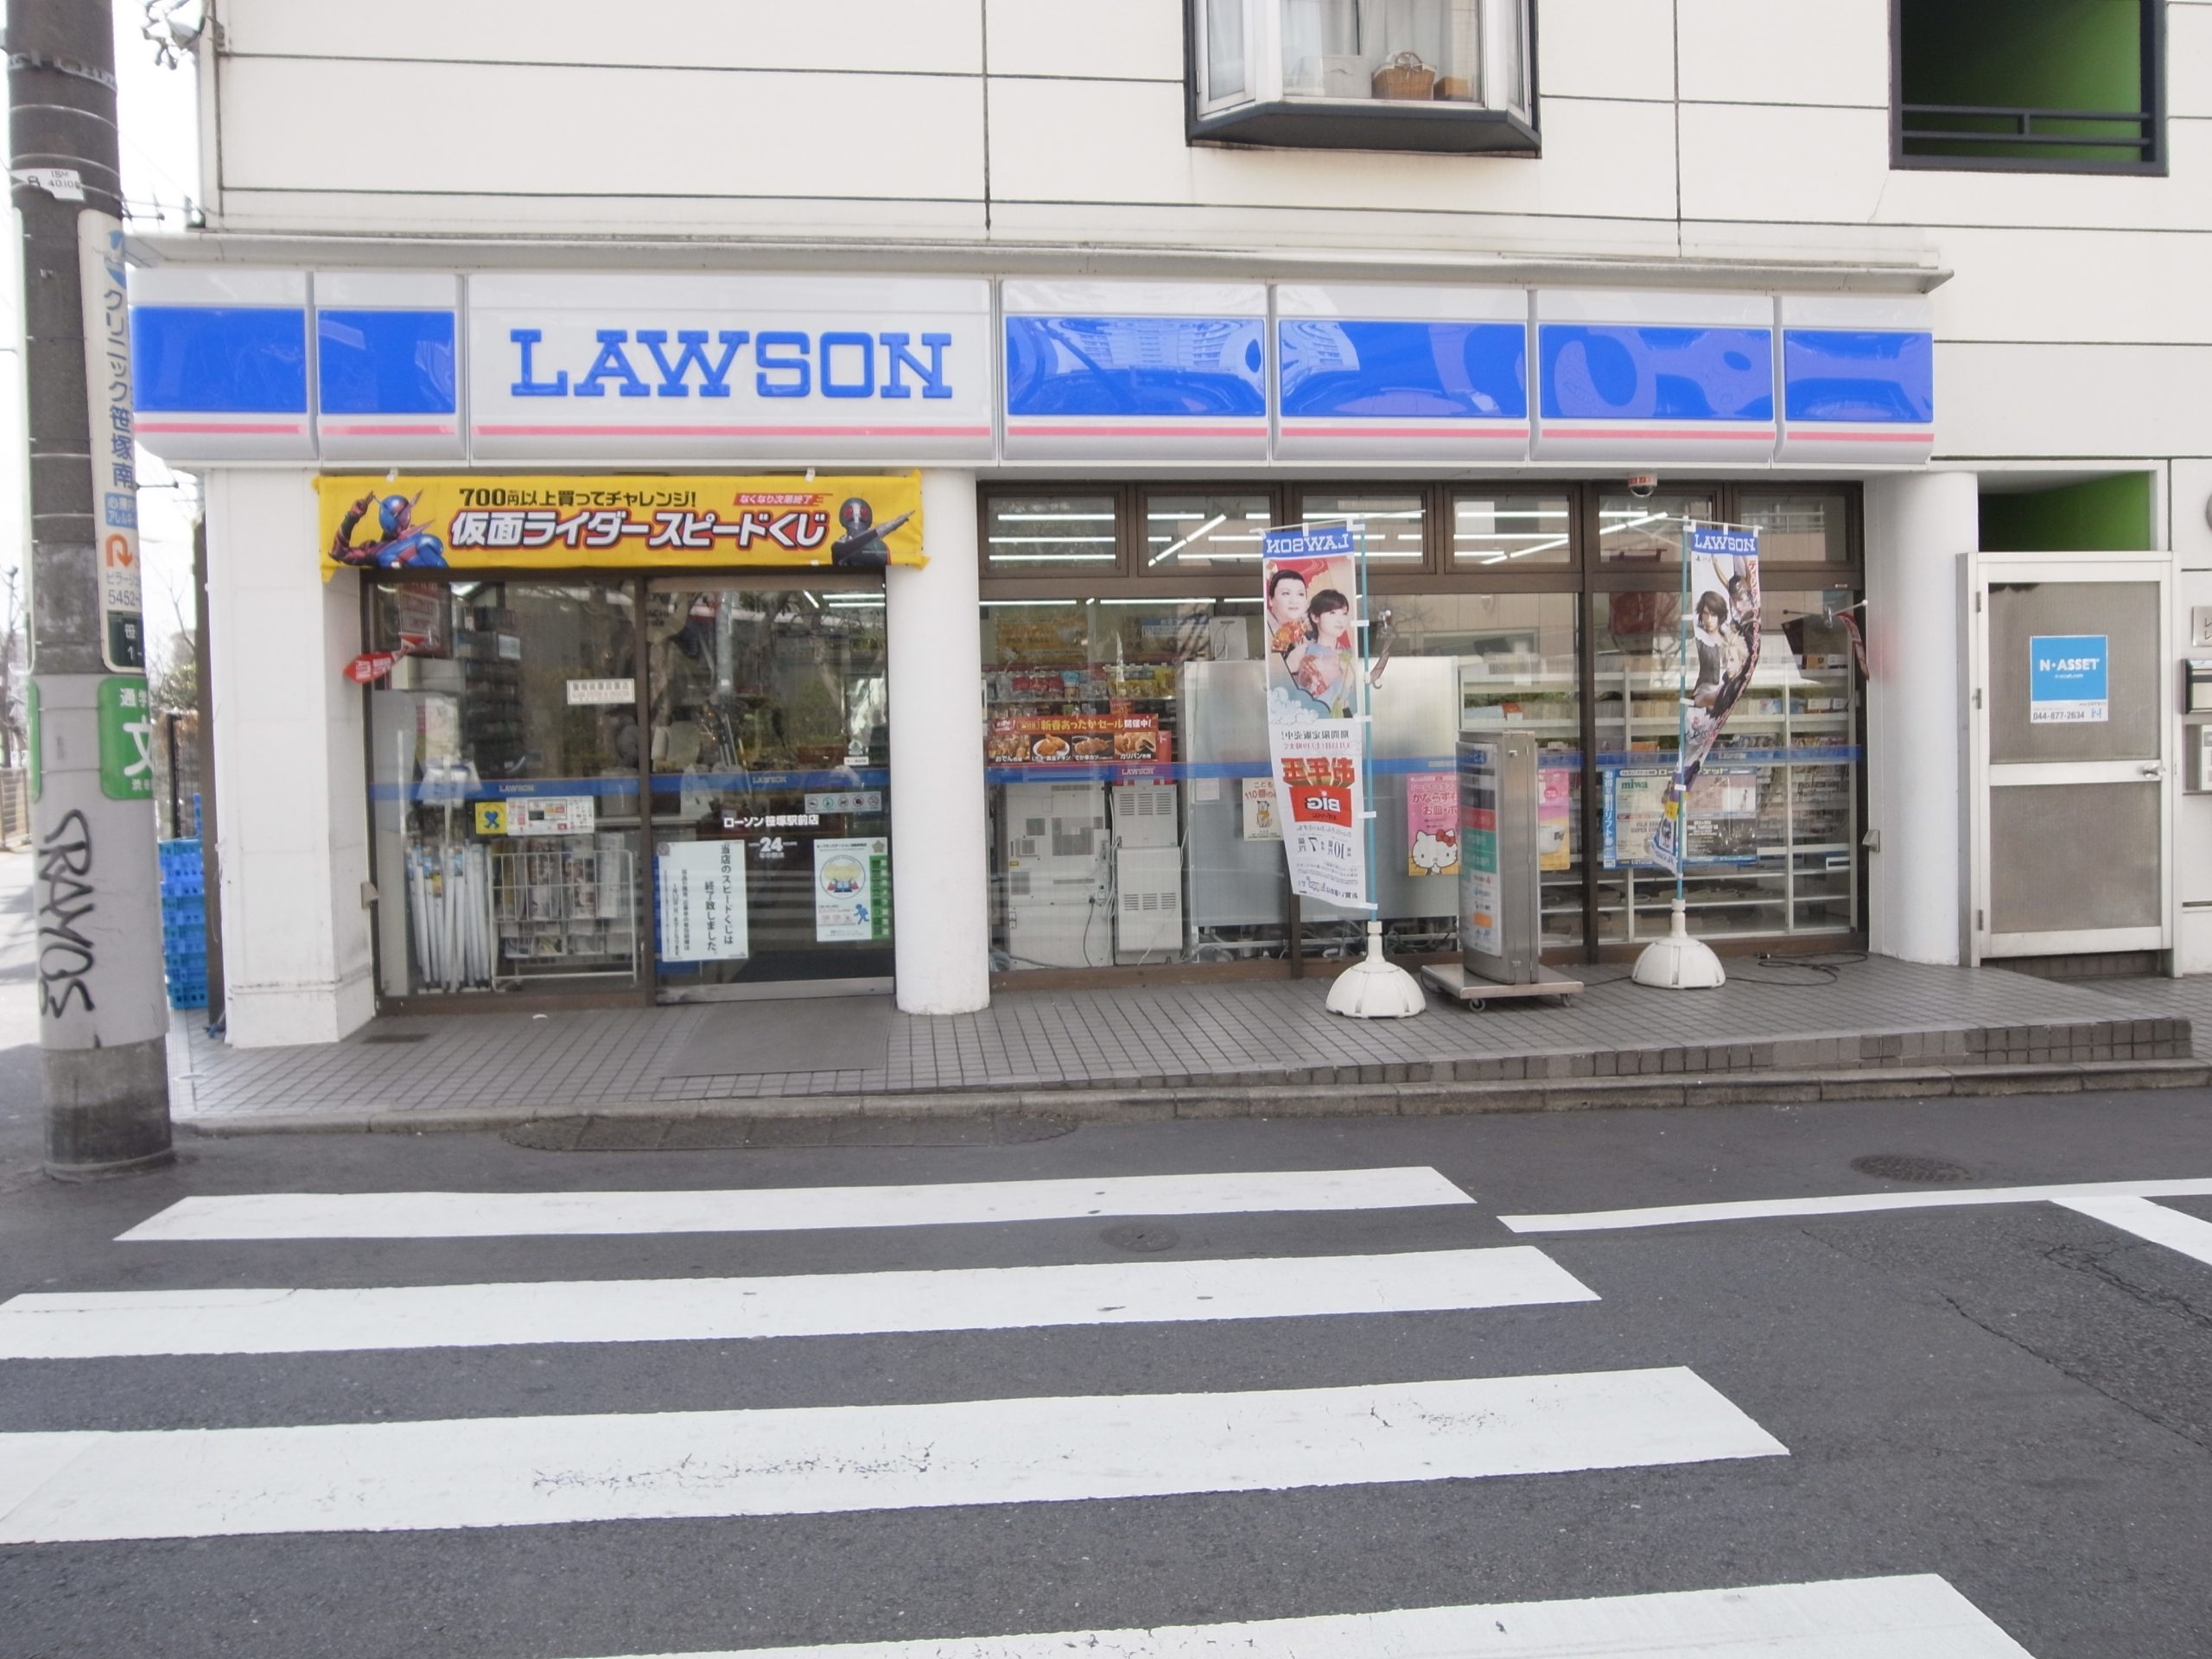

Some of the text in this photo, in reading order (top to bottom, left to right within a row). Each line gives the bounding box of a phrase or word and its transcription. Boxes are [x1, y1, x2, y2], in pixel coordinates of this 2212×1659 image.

[510, 328, 953, 399] LAWSON
[450, 508, 827, 549] 仮面ライダースピードくじ
[1694, 533, 1756, 552] LAWSON
[108, 589, 142, 606] 5452-
[1621, 778, 1649, 790] miwa
[760, 836, 784, 853] 24
